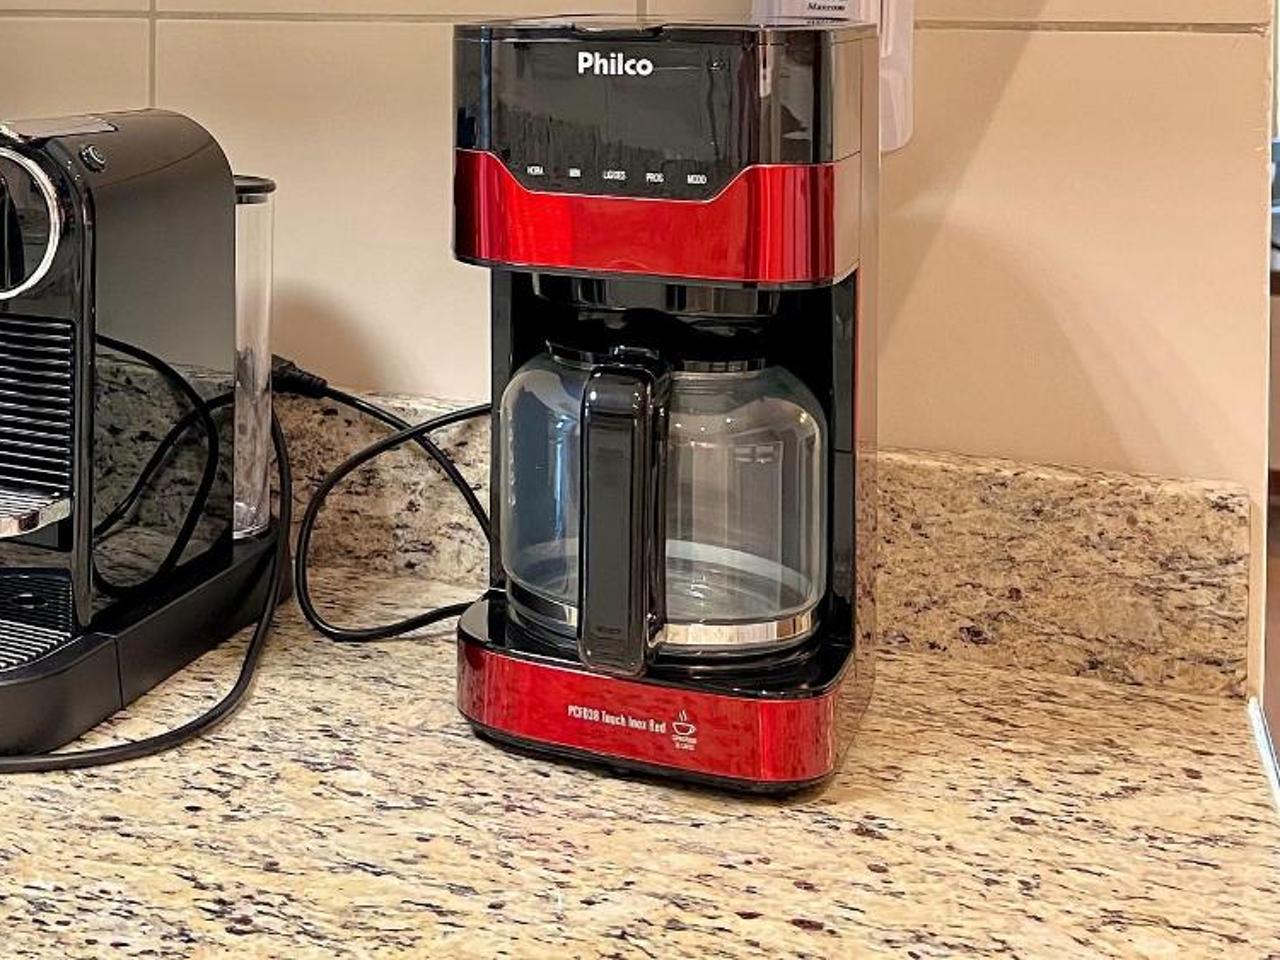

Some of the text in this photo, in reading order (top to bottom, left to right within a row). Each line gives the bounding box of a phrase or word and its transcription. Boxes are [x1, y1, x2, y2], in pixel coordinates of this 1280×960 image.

[577, 51, 653, 77] Philco
[527, 165, 545, 176] HORA
[645, 172, 665, 183] PROG
[686, 174, 708, 185] MODO
[601, 710, 626, 727] Touch
